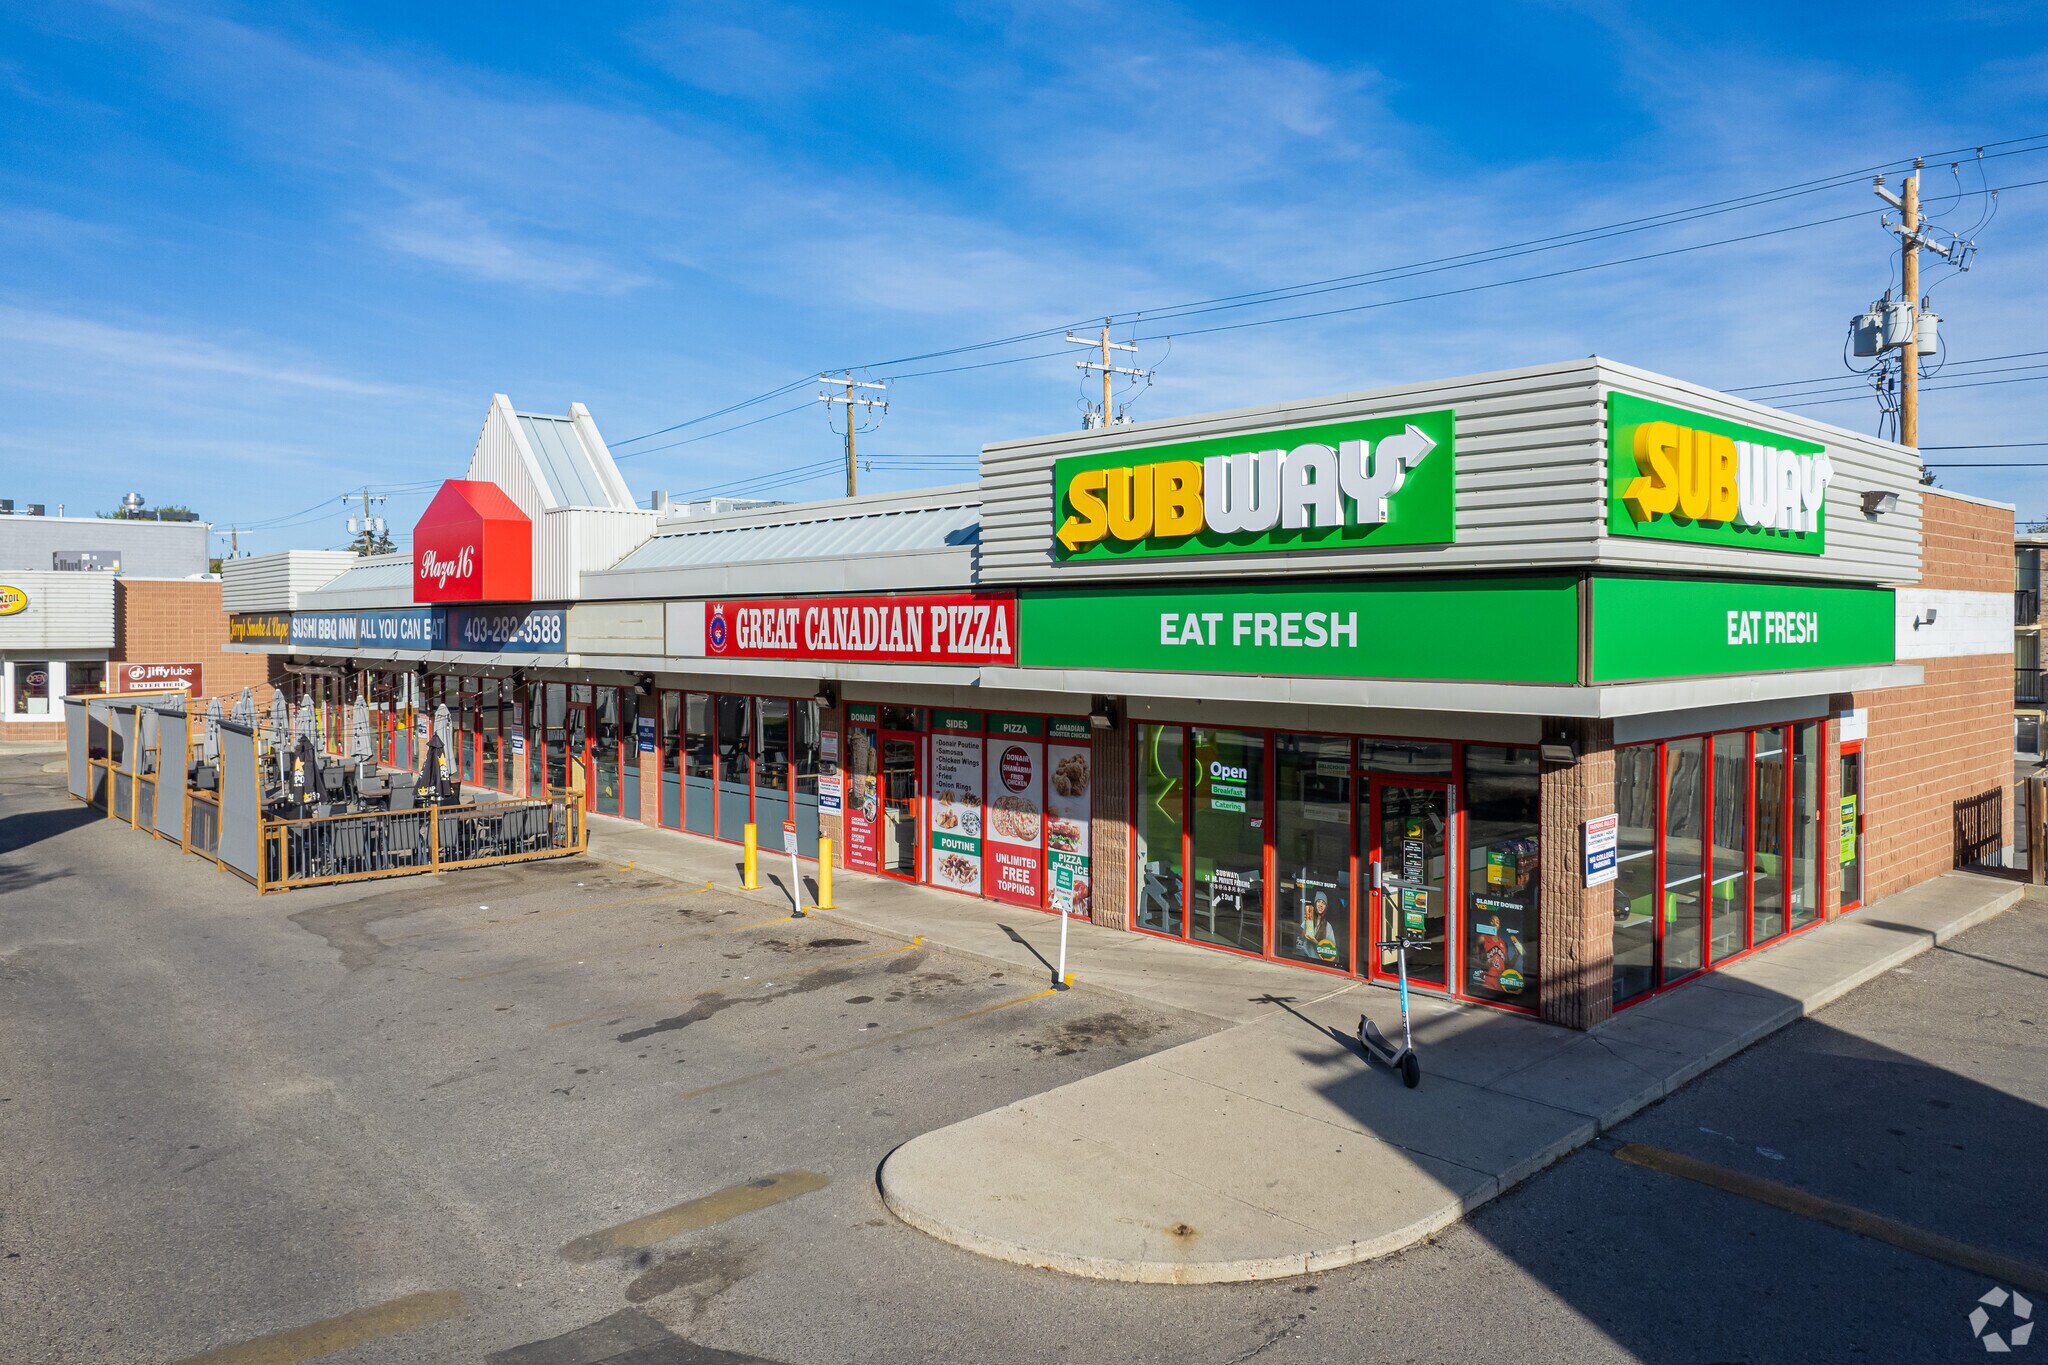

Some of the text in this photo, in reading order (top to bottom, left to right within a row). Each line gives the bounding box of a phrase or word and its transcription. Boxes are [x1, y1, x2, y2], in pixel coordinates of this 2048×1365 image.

[1622, 420, 1835, 533] SUBWAY
[1056, 423, 1437, 552] SUBWAY
[421, 545, 475, 590] Plaza 16
[230, 618, 246, 642] Jerry's
[246, 616, 266, 637] Smoke
[272, 616, 289, 644] Vape
[292, 617, 357, 641] SUSHI BBQ INN
[360, 617, 445, 640] ALL YOU CAN EAT
[464, 615, 562, 644] 403-282-3588
[736, 607, 800, 650] GREAT
[804, 605, 923, 652] CANADIAN
[930, 604, 1012, 655] PIZZA
[1160, 611, 1359, 648] EAT FRESH
[1727, 610, 1818, 645] EAT FRESH
[851, 713, 876, 722] DONAIR
[946, 719, 968, 730] SIDES
[1003, 723, 1028, 734] PIZZA
[1055, 724, 1085, 732] CANADIAN
[938, 739, 980, 750] Donair Poutine
[938, 747, 964, 756] Samosas
[938, 755, 980, 768] Chicken Wings
[938, 763, 957, 772] Salads
[938, 772, 952, 780] Fries
[1210, 761, 1247, 781] Open
[938, 780, 972, 792] Onion Rings
[1213, 785, 1244, 796] Breakfast
[1215, 800, 1242, 812] Catering
[941, 838, 975, 852] POUTINE
[995, 853, 1037, 869] UNLIMITED
[1058, 853, 1082, 866] PIZZA
[1002, 866, 1030, 884] FREE
[1215, 869, 1238, 879] SUBWAY
[997, 880, 1035, 896] TOPPINGS
[1476, 897, 1493, 906] SLAM
[1500, 900, 1524, 911] DOWN?
